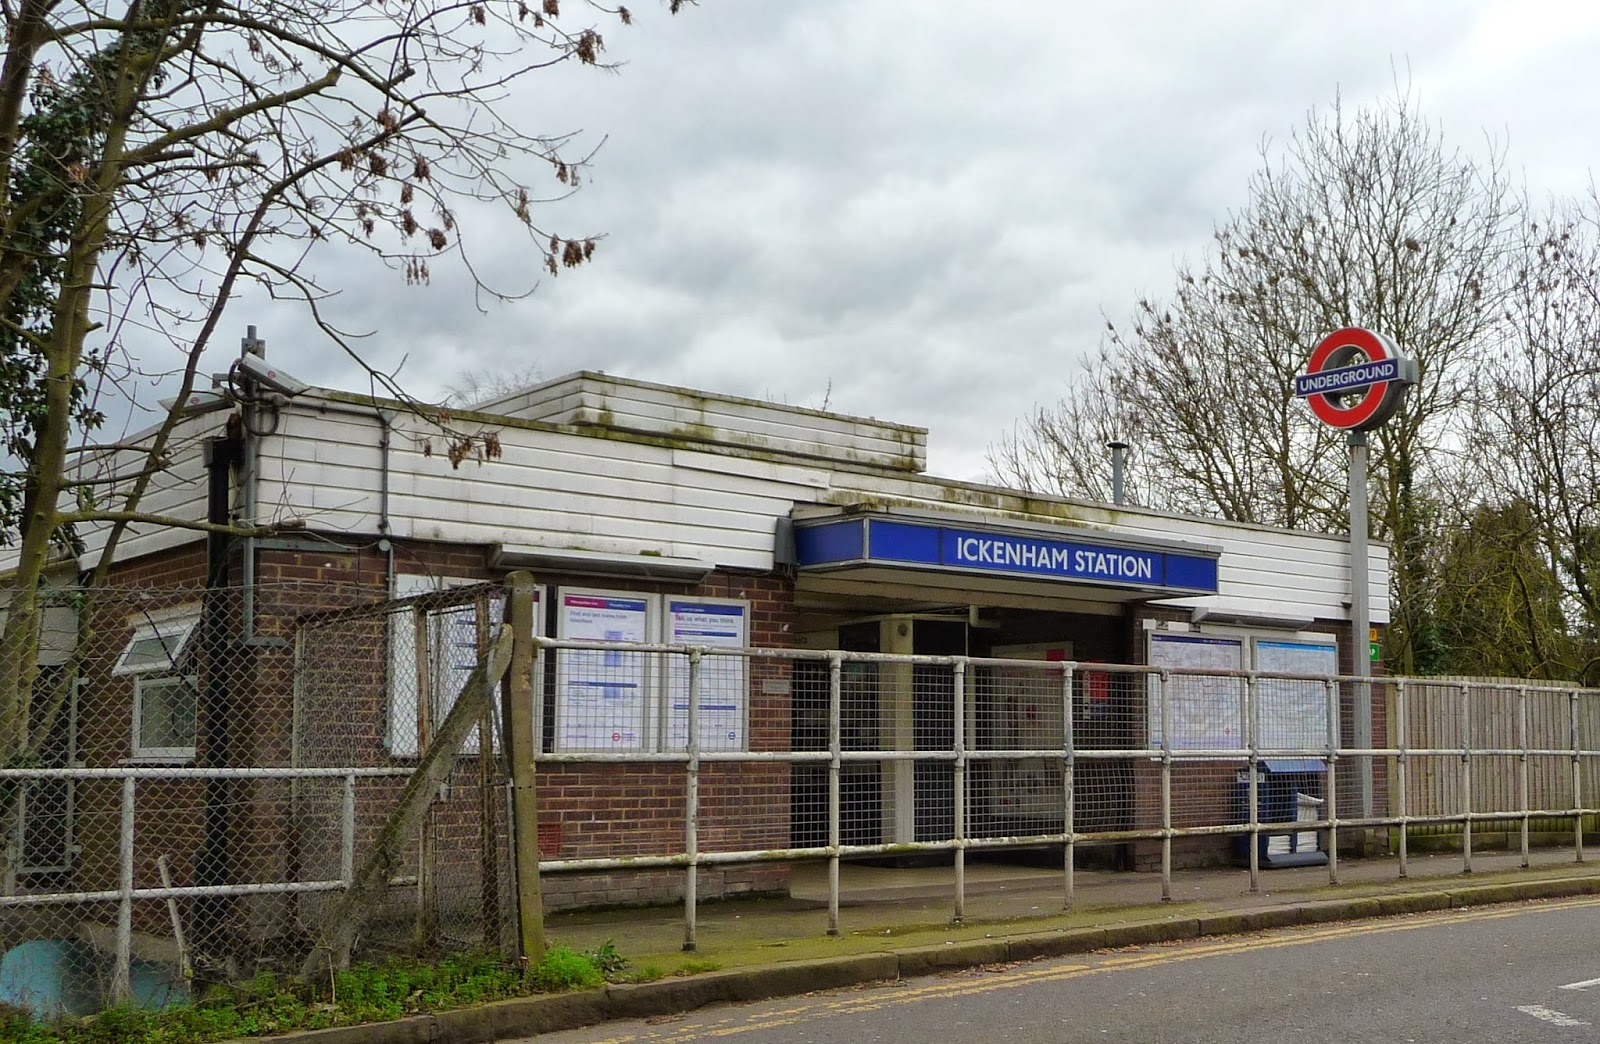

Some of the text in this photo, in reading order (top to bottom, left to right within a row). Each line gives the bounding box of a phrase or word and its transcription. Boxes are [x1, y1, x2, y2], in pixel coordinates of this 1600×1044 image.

[1300, 363, 1394, 391] UNDERGROUND
[957, 537, 1151, 578] ICKENHAM STATION
